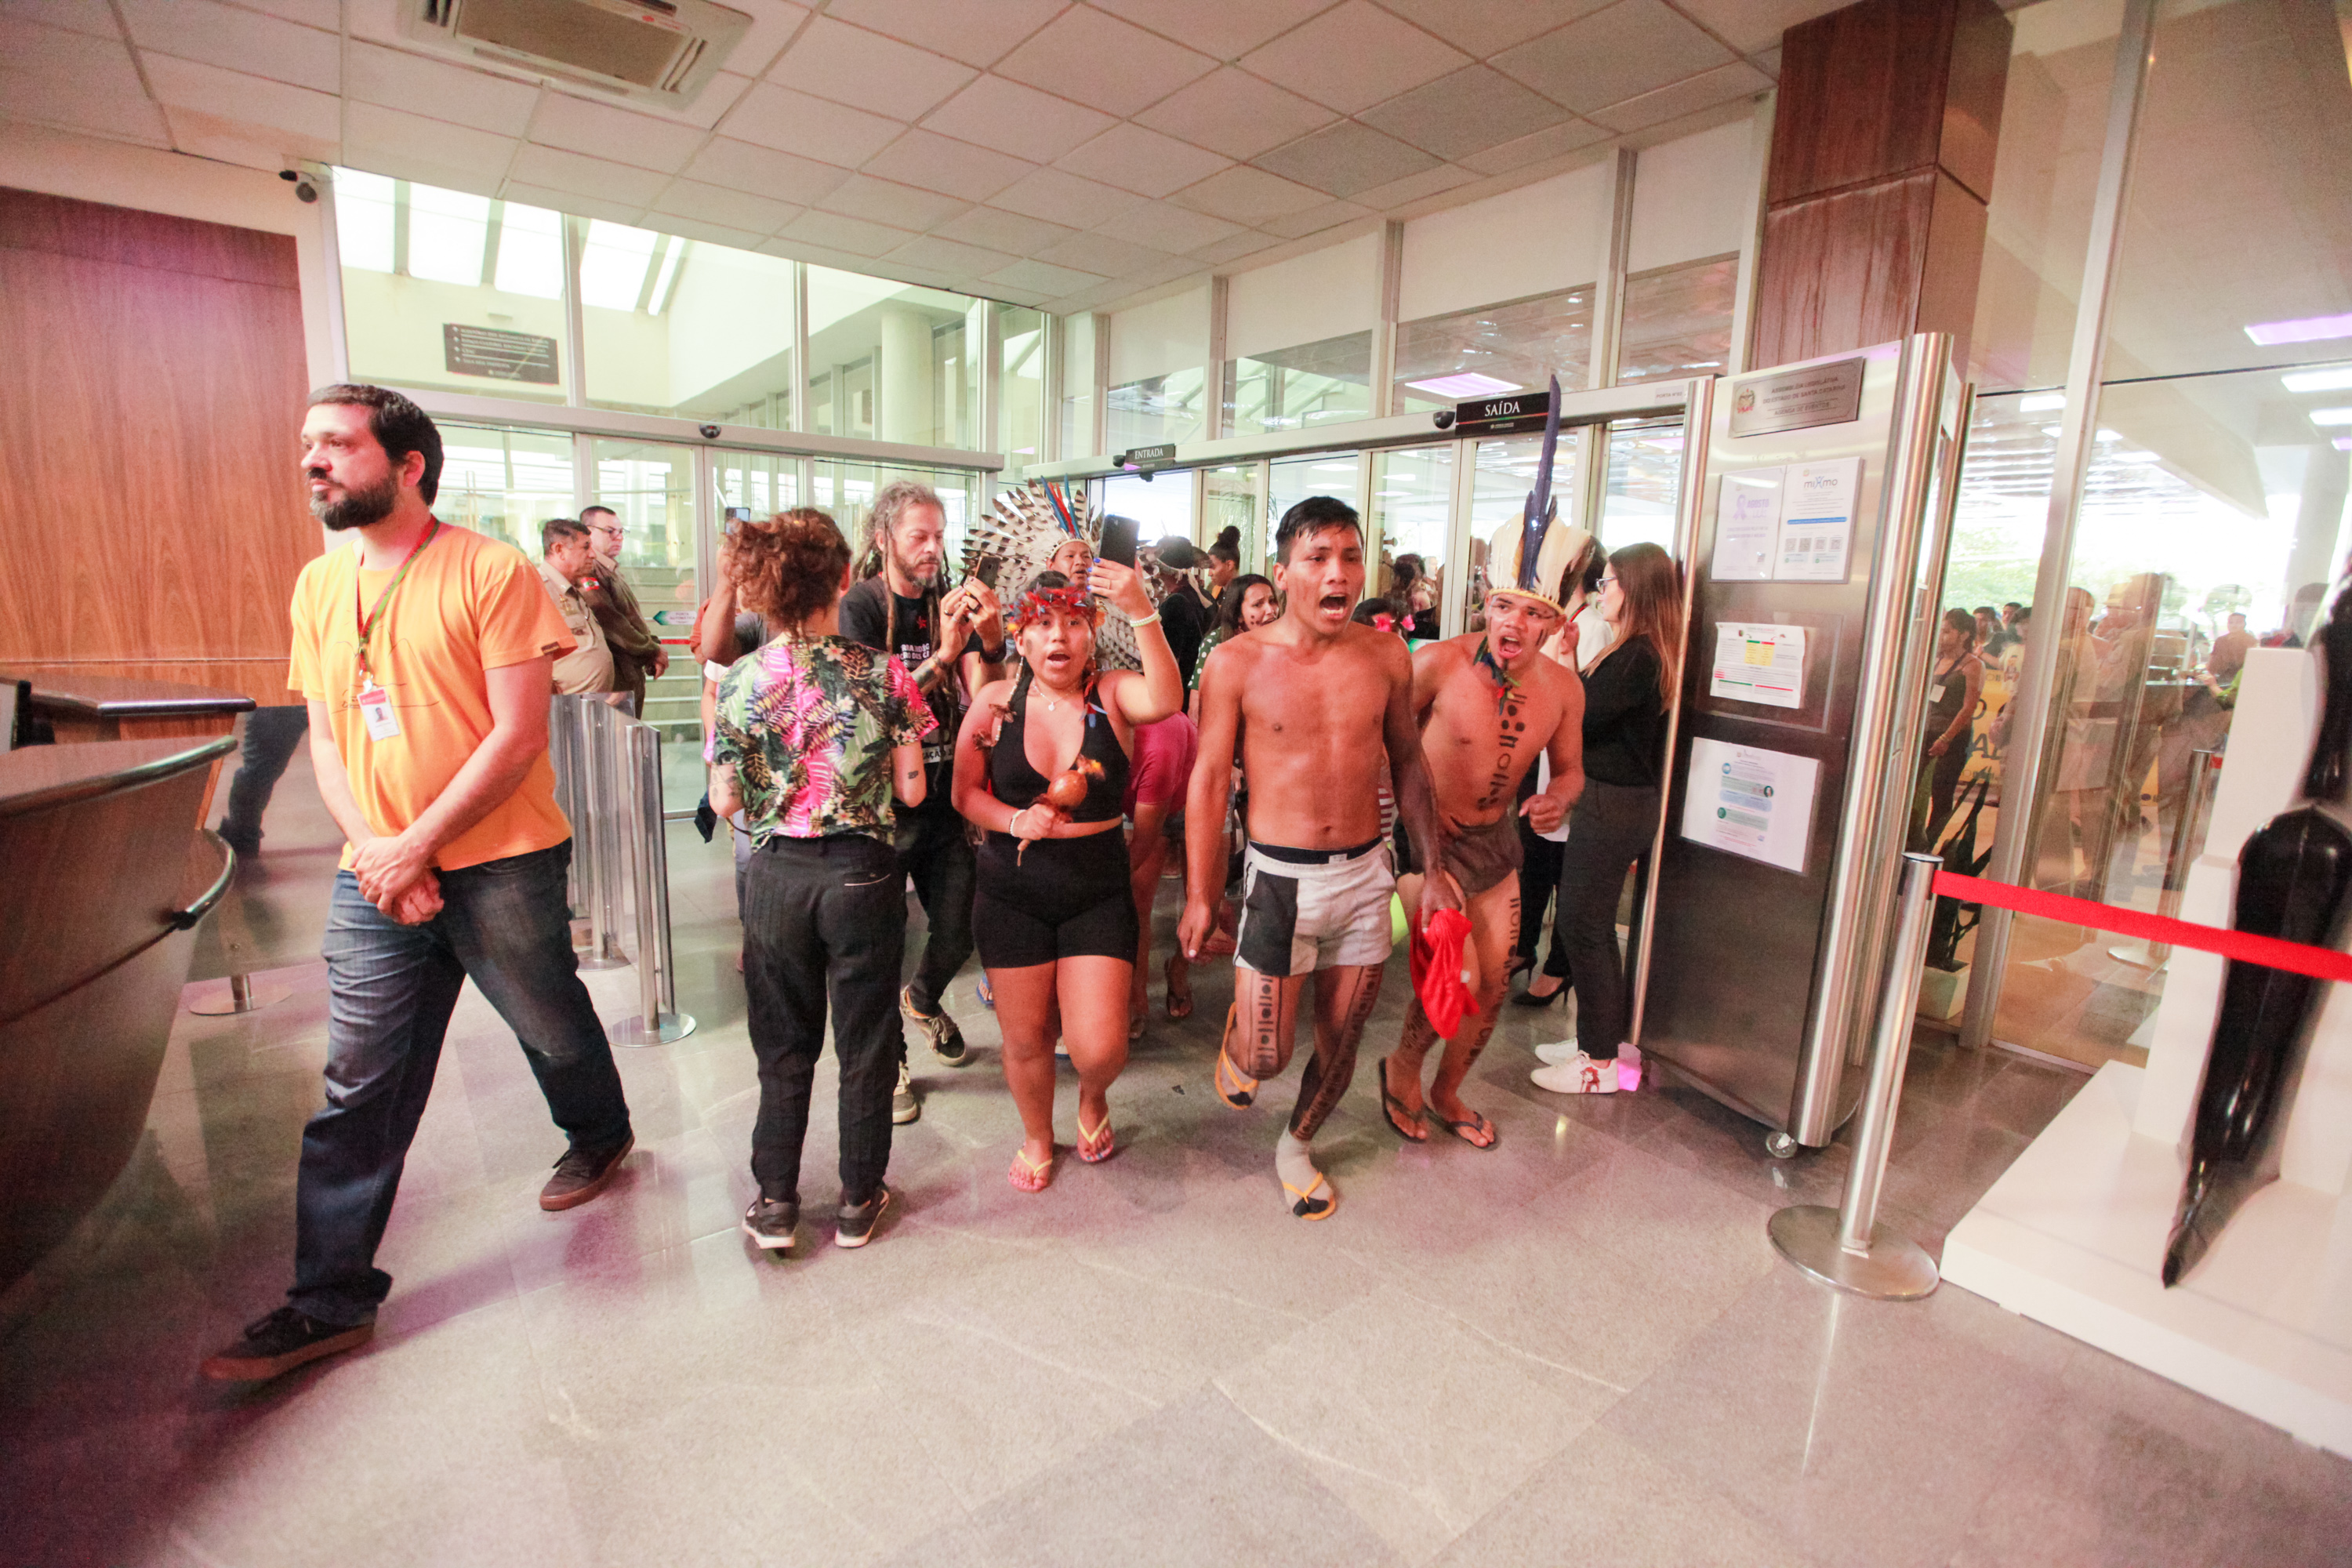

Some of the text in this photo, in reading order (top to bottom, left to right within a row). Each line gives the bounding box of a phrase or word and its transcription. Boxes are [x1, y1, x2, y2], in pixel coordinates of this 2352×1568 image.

[1771, 394, 1791, 403] ESTADO
[1484, 401, 1520, 416] SAÍDA
[1134, 448, 1163, 459] ENTRADA
